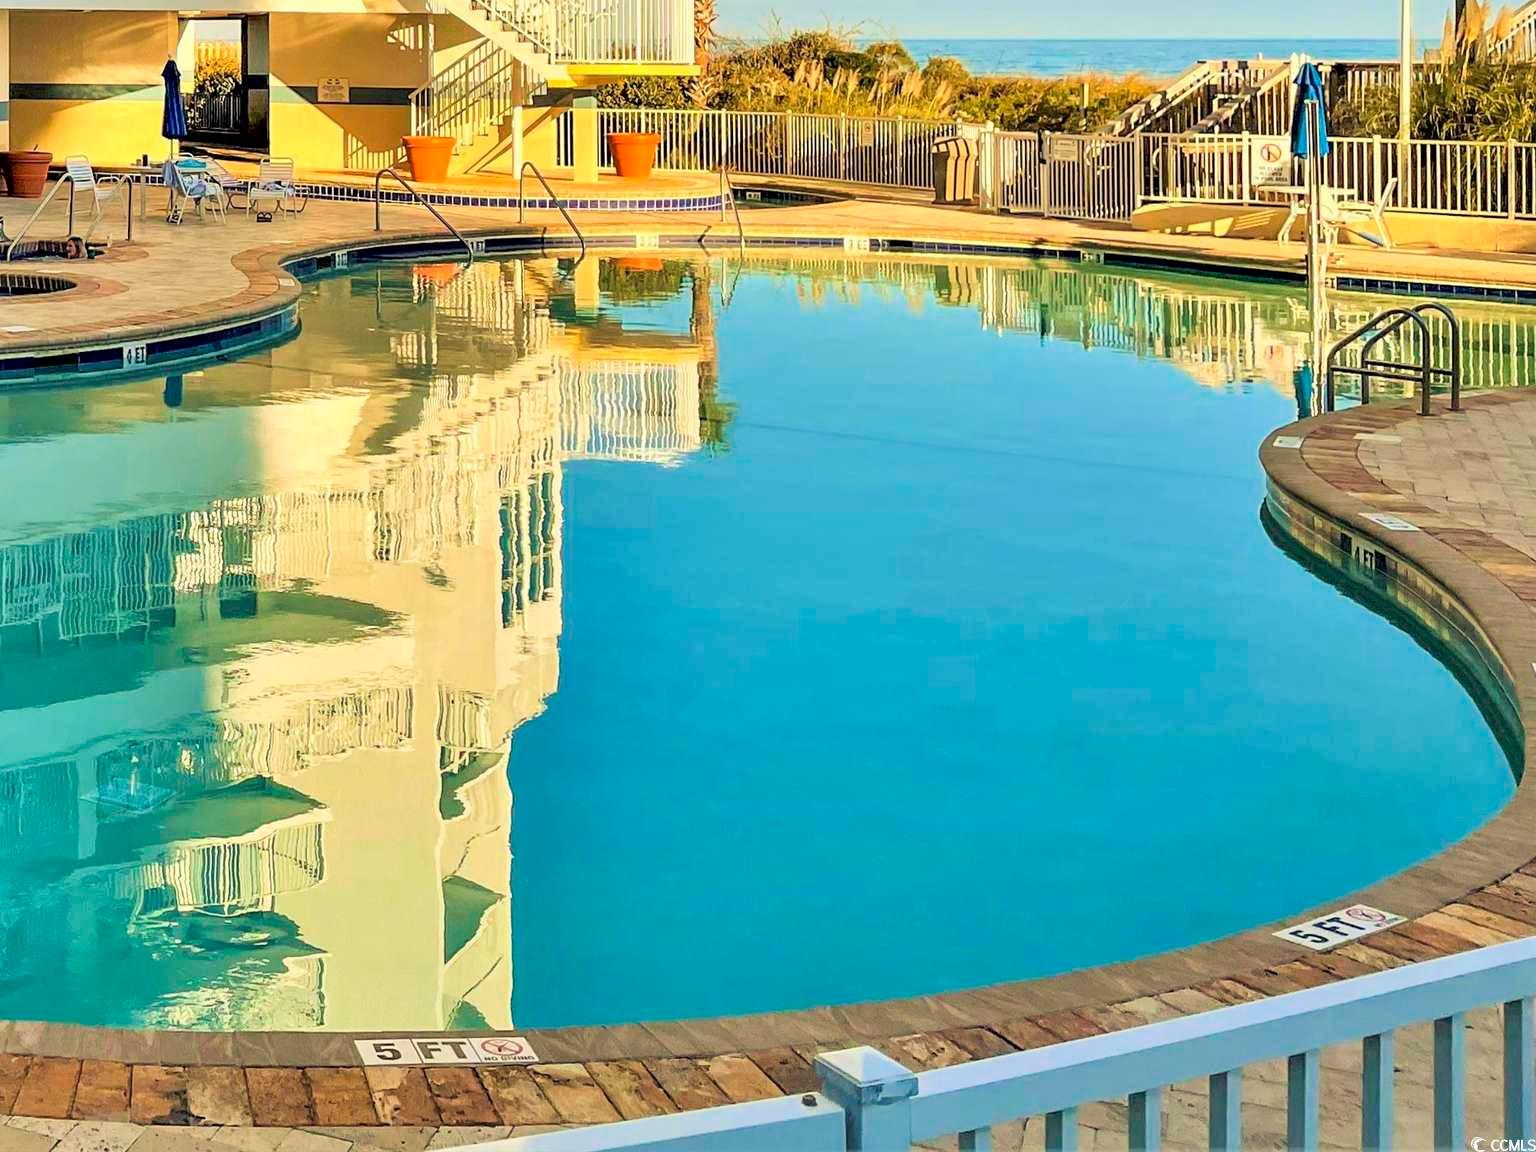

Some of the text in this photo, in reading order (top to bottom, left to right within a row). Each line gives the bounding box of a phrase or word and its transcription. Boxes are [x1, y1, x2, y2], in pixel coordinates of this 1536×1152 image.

[1289, 930, 1329, 944] 5
[1312, 917, 1366, 937] FT
[372, 1041, 468, 1061] 5 FT
